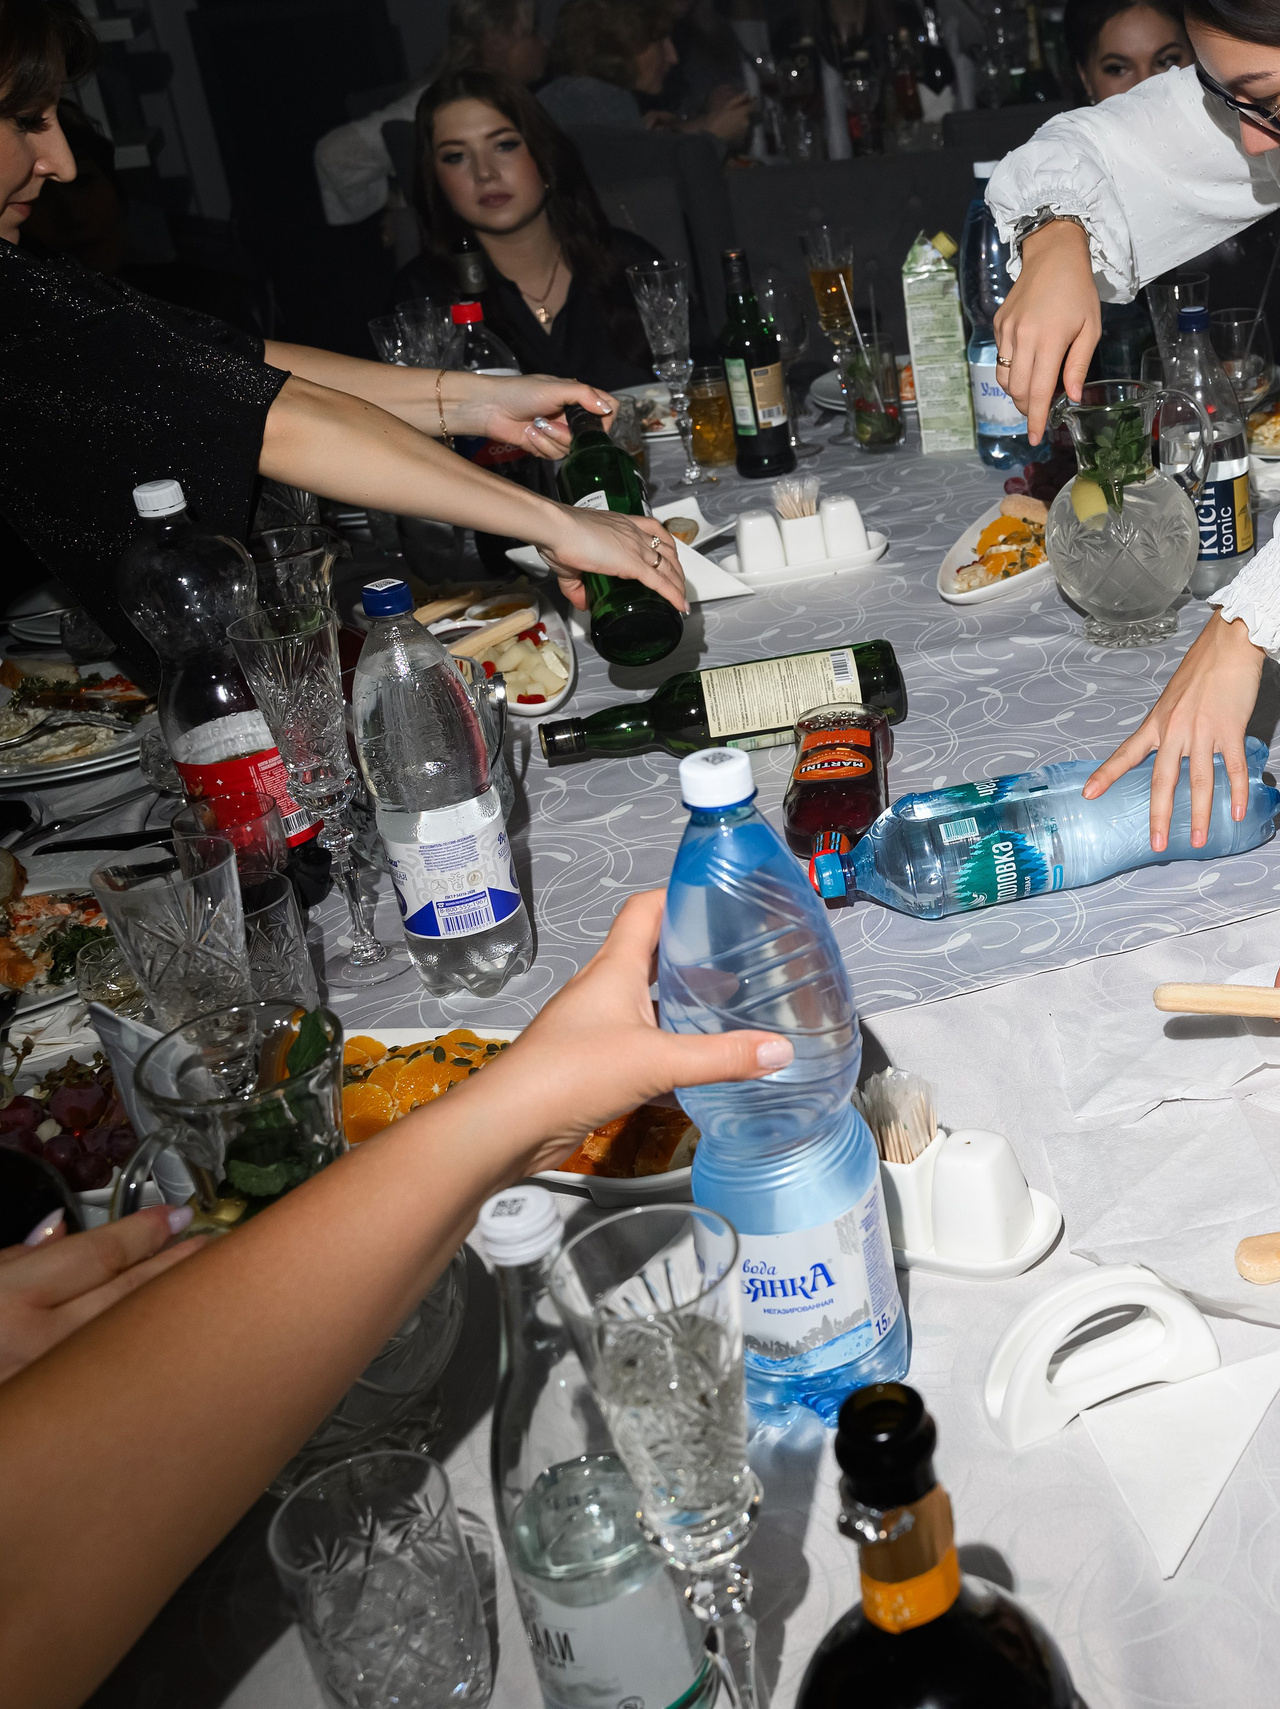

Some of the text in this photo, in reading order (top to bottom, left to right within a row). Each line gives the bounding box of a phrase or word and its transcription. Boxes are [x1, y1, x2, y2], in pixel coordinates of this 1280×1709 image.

[1217, 505, 1234, 554] tonic
[801, 760, 864, 773] MARTINI
[742, 1258, 777, 1276] вода
[762, 1298, 834, 1315] НЕГАЗИРОВАННАЯ
